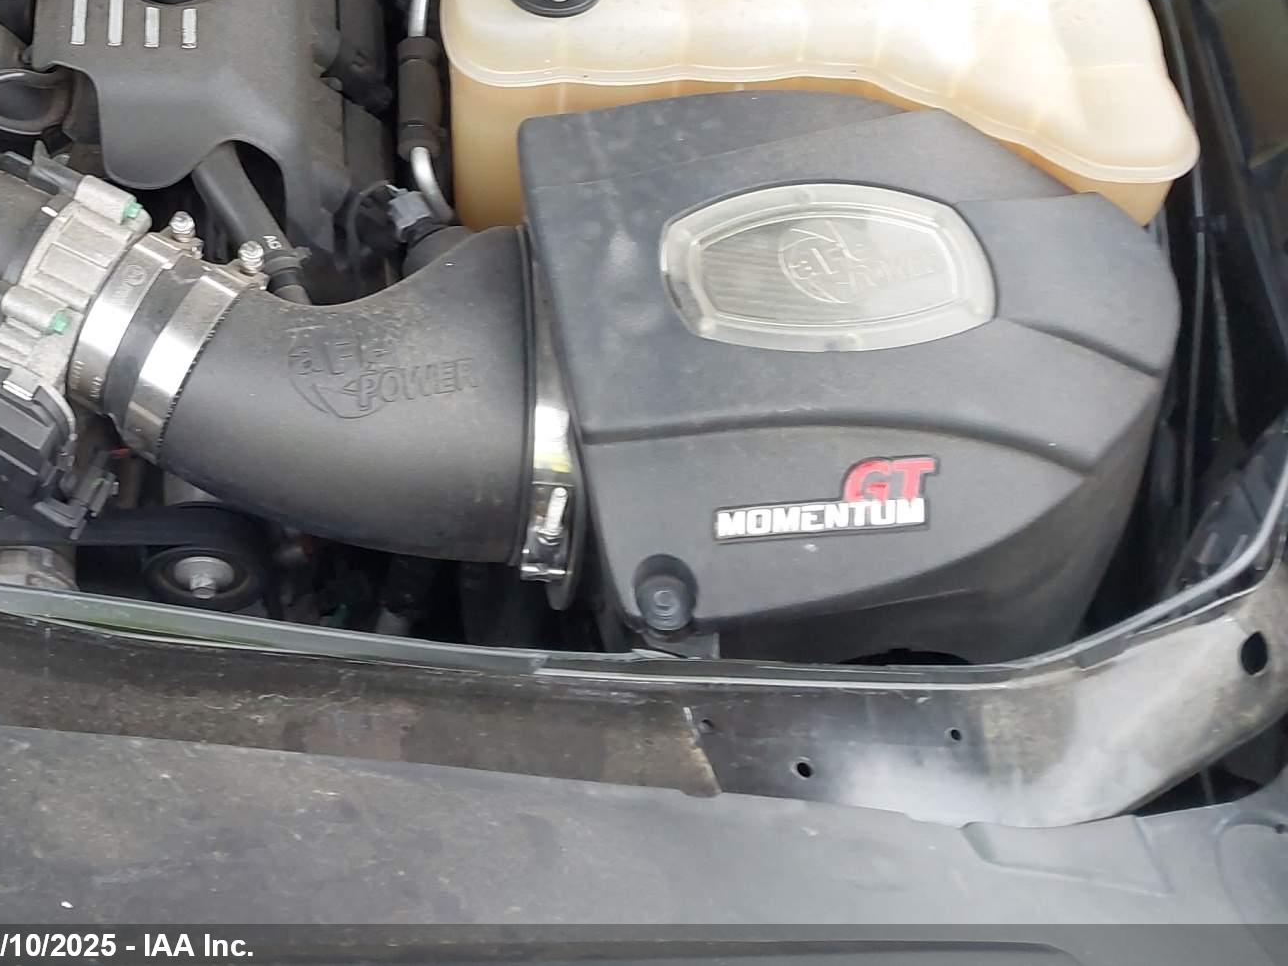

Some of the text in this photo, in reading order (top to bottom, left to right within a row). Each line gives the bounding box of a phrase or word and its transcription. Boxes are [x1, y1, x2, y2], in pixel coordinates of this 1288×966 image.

[358, 358, 480, 412] POWER
[843, 457, 936, 504] GT
[716, 497, 926, 538] MOMENTUM
